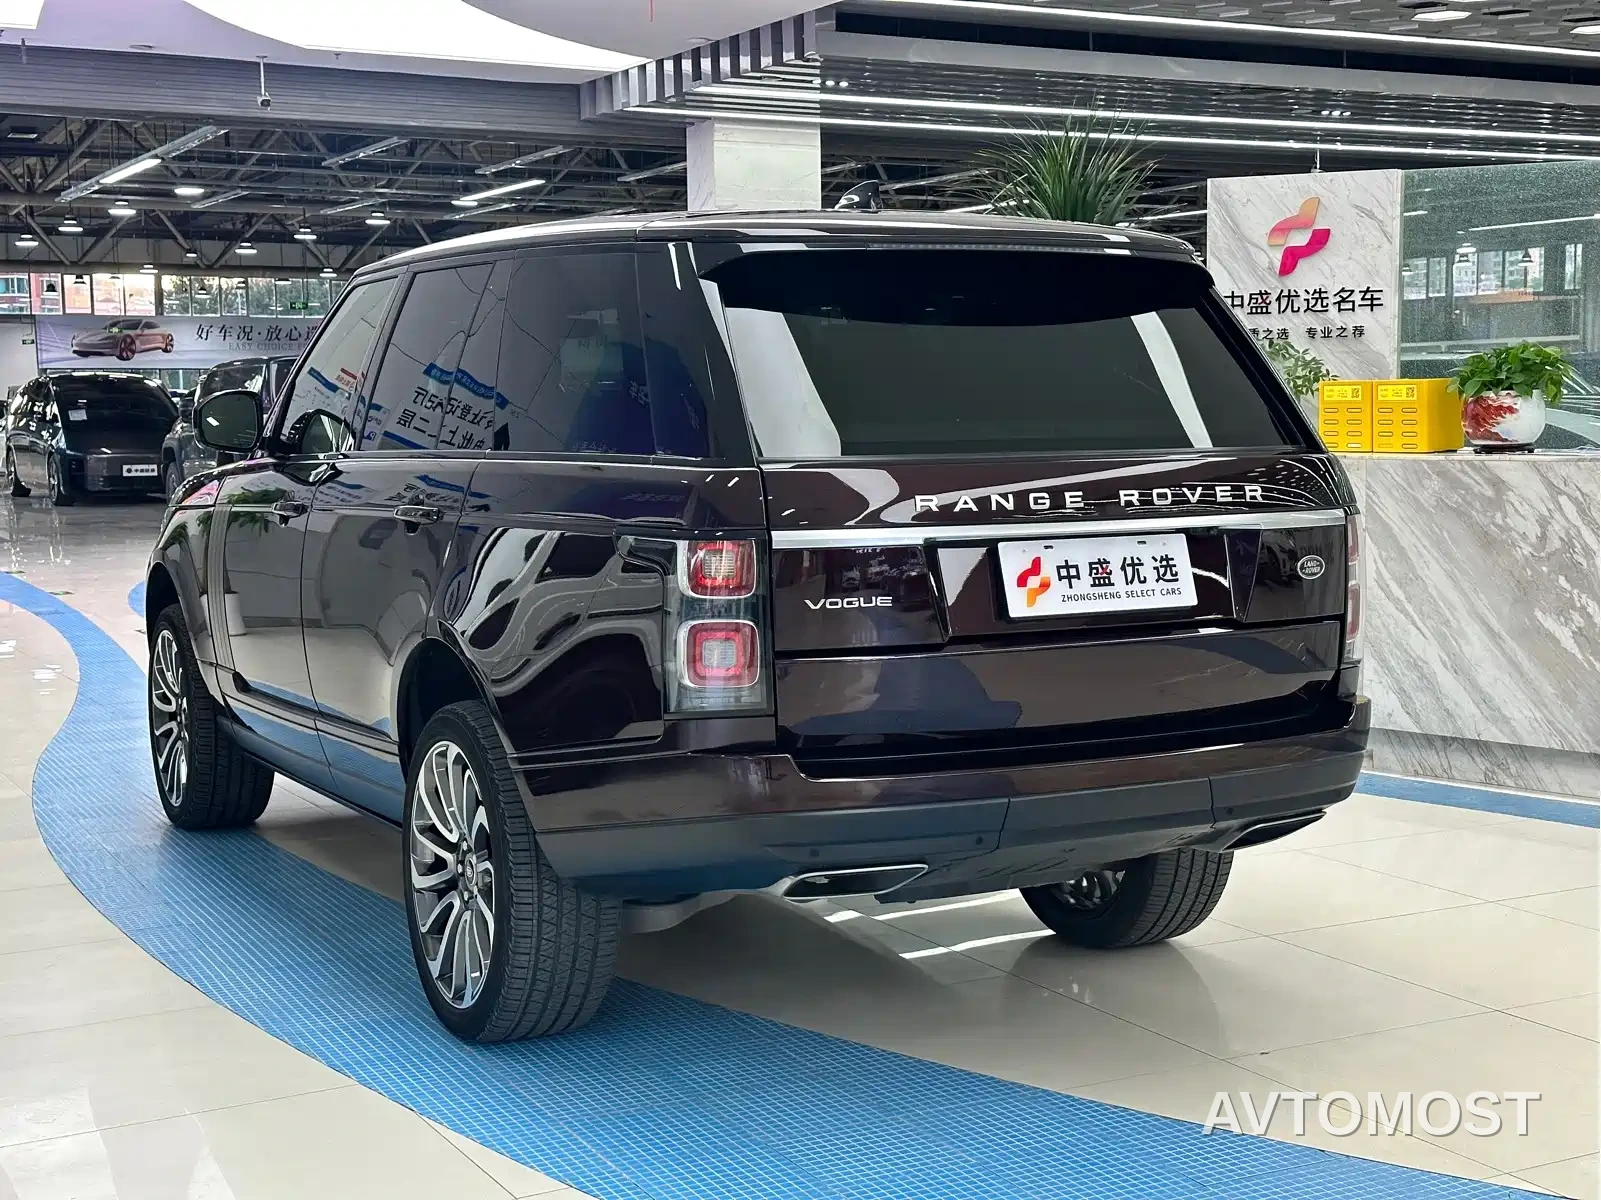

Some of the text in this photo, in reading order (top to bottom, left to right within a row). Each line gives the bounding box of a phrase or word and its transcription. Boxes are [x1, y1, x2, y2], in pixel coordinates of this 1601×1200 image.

[1305, 325, 1365, 339] 专业之荐
[914, 485, 1264, 512] RANGE ROVER
[1056, 554, 1180, 589] 中盛优选
[1061, 587, 1182, 602] ZHONGSHENG SELECT CARS
[804, 596, 893, 610] VOGUE
